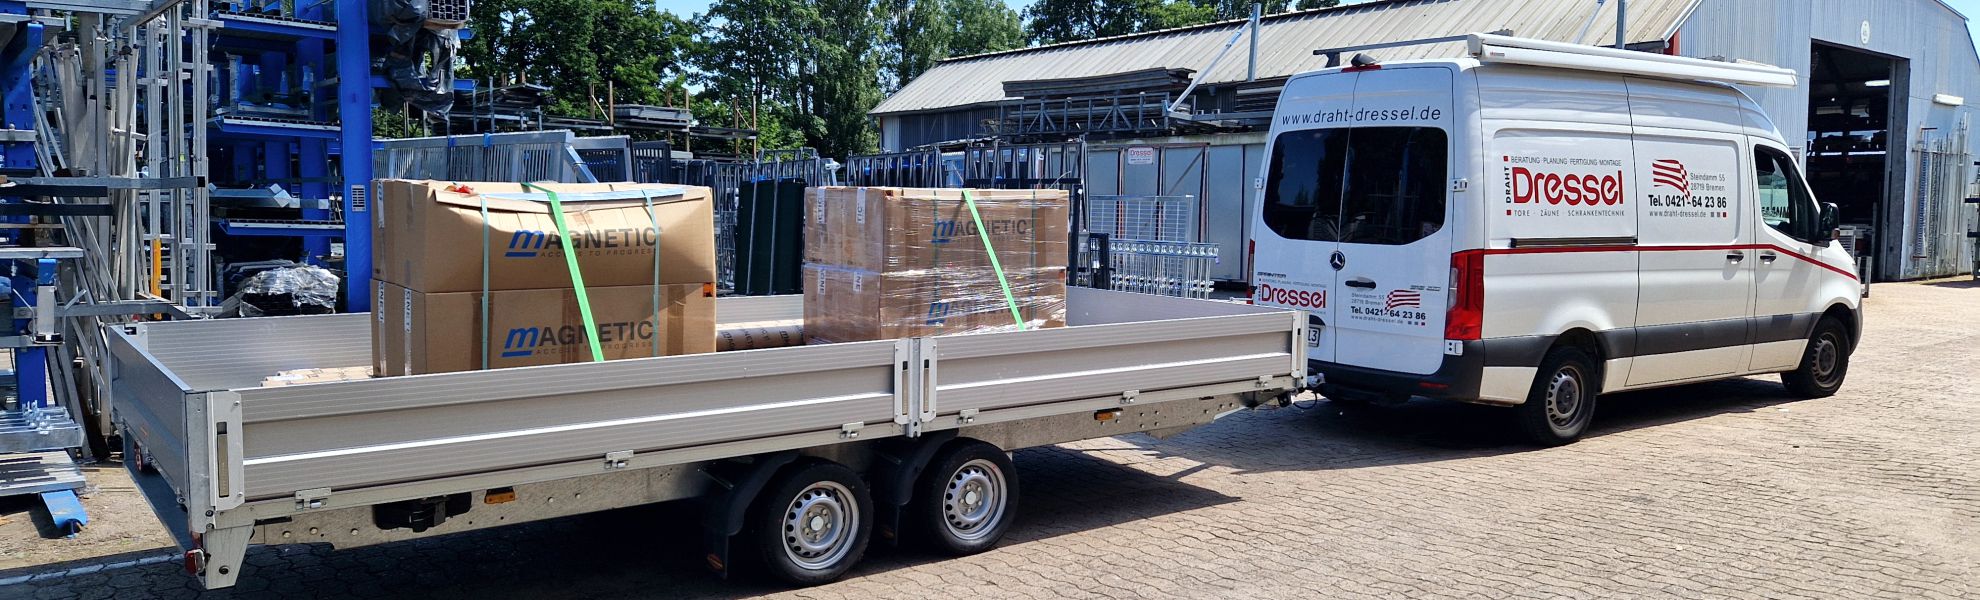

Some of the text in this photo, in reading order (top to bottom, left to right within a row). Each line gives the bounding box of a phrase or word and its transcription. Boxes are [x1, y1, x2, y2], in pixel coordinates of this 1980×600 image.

[1282, 106, 1441, 125] www.draht-dressel.de
[1511, 156, 1622, 167] BERATUNG PLANUNG FERTIGUNG MONTAGE
[1690, 173, 1717, 181] Steindamm
[1503, 166, 1512, 203] DRAHT
[1512, 166, 1624, 206] Dressel
[1690, 183, 1705, 191] 28719
[1648, 194, 1663, 207] Tel.
[1705, 196, 1715, 208] 23
[1717, 196, 1727, 208] 86
[1514, 209, 1625, 217] TORE ZÄUNE SCHRANKENTECHNIK
[1649, 210, 1706, 218] www.draht-dressel.de
[1262, 283, 1327, 309] Dressel
[1350, 306, 1363, 314] Tel.
[1402, 311, 1413, 319] 23
[1415, 312, 1426, 320] 86
